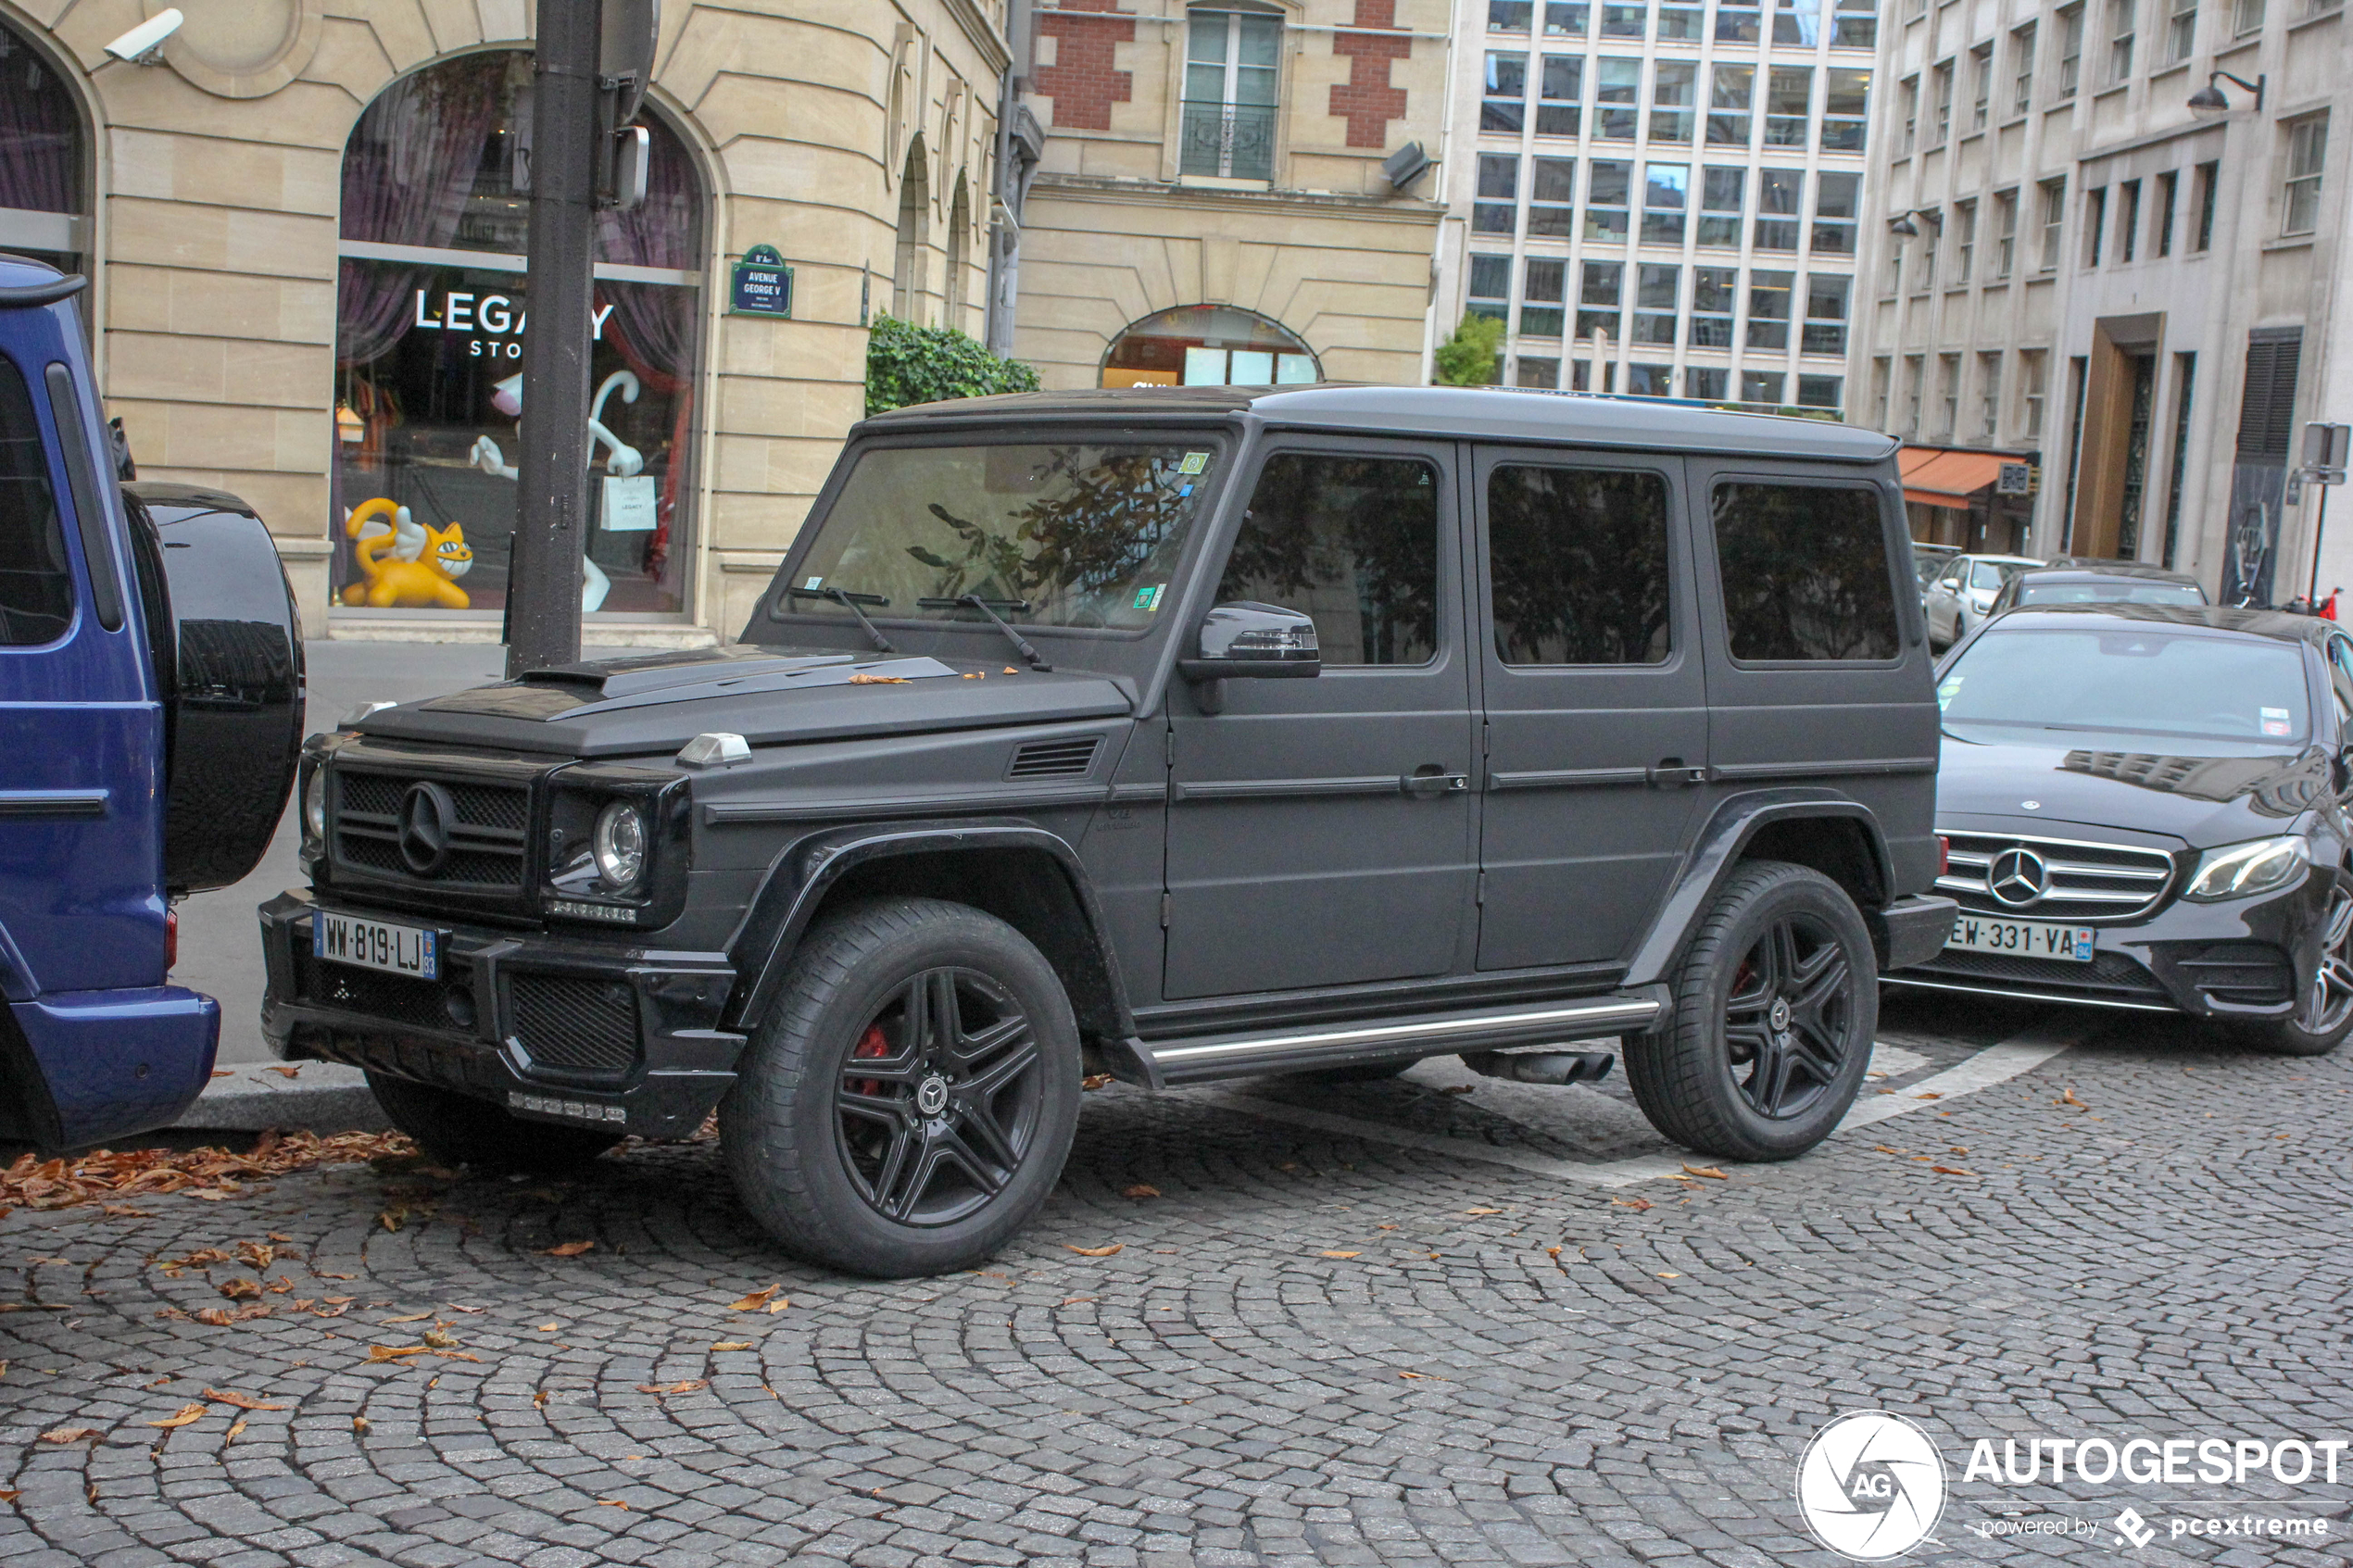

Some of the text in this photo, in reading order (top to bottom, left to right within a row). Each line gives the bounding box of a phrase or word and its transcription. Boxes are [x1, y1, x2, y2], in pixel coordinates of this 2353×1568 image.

[744, 283, 781, 295] GEORGE V
[749, 271, 778, 283] AVENUE
[416, 289, 614, 341] LEGY
[470, 340, 522, 359] STO
[326, 918, 421, 971] WW-819-LJ
[1950, 920, 2073, 955] EW-331-VA
